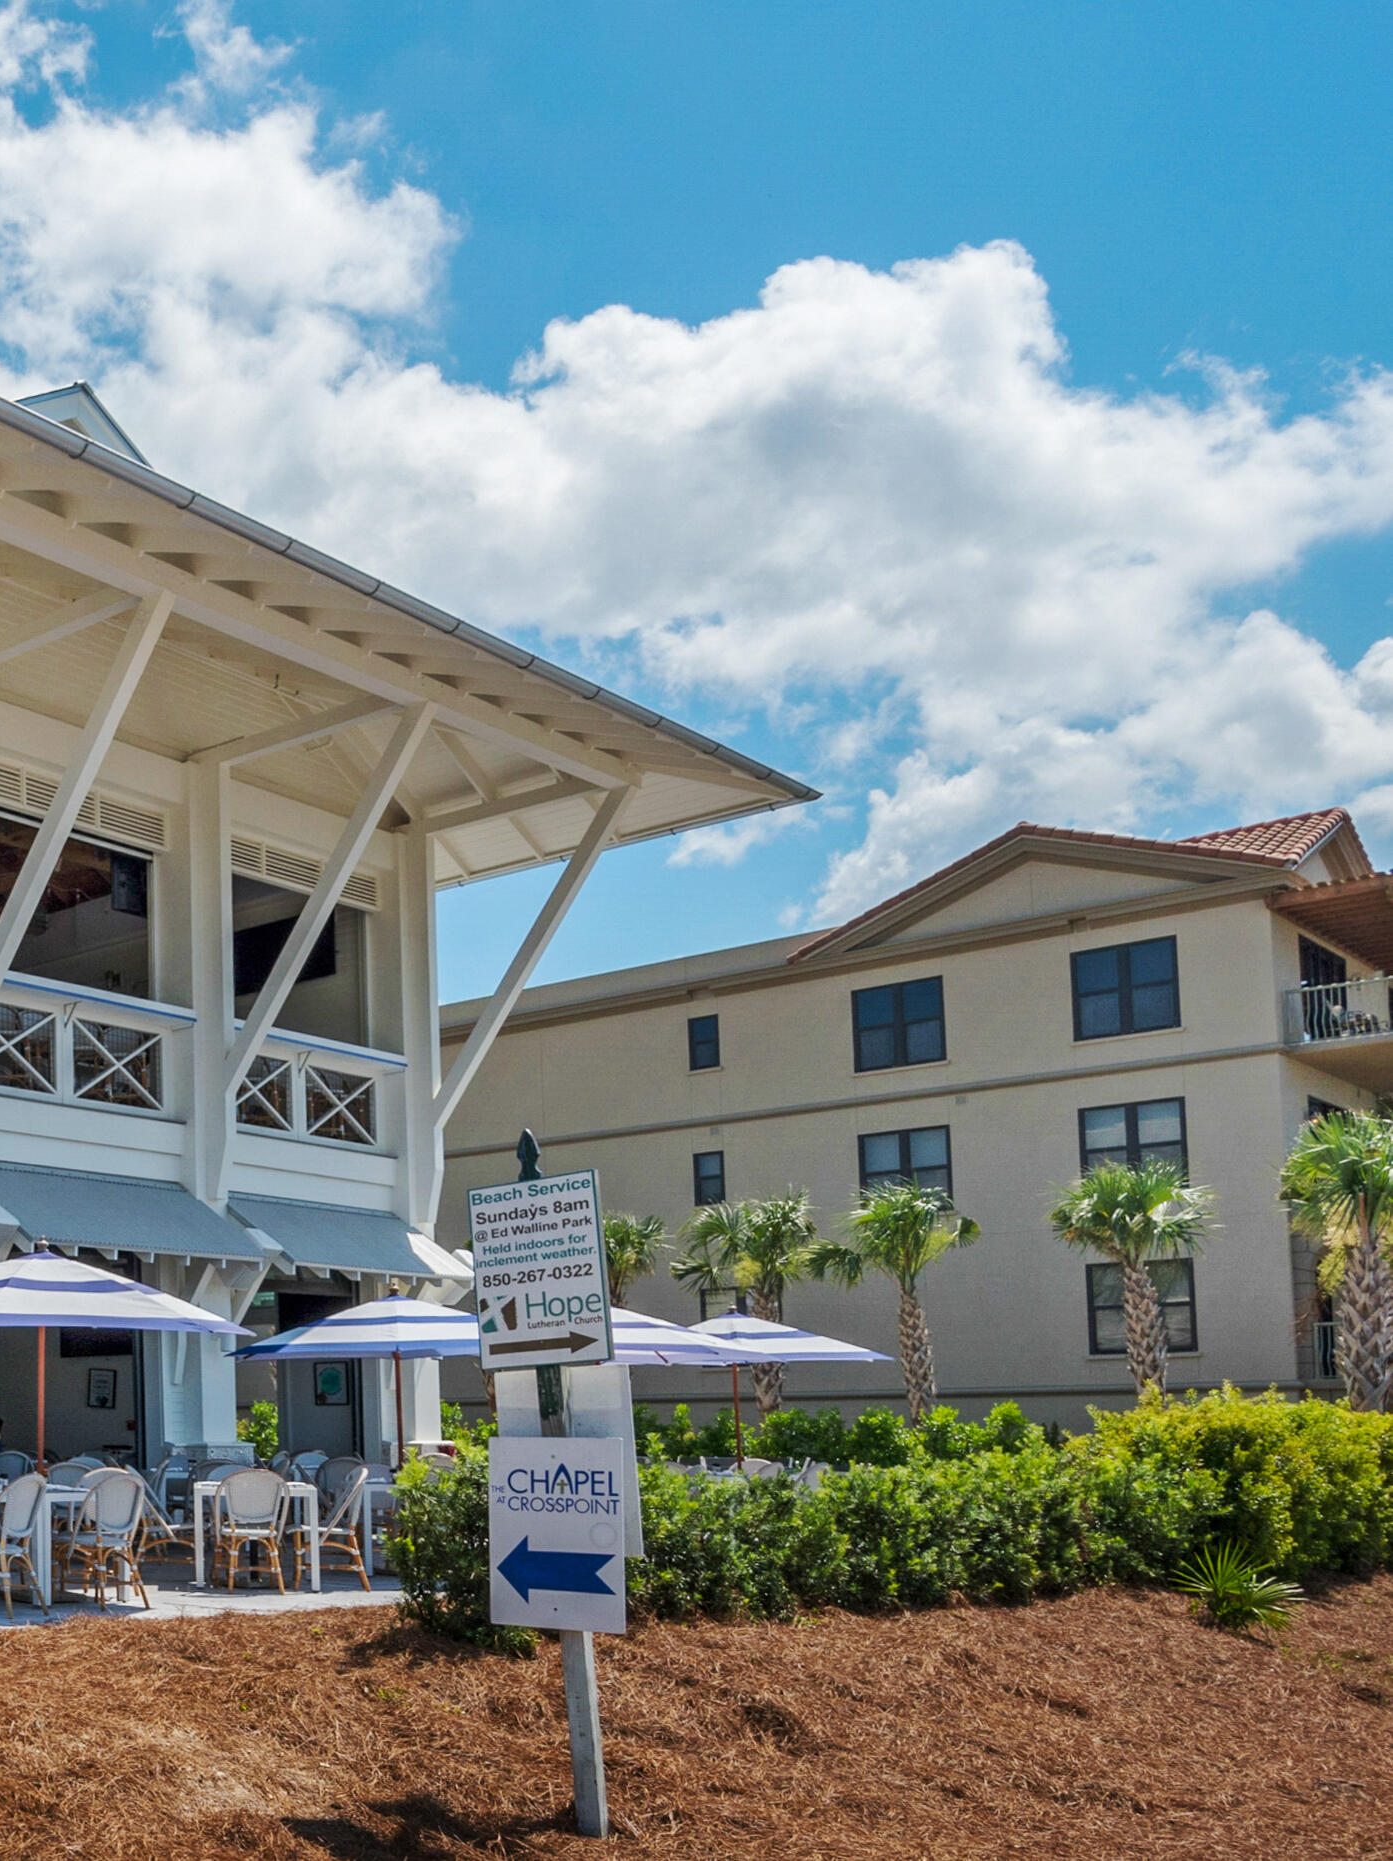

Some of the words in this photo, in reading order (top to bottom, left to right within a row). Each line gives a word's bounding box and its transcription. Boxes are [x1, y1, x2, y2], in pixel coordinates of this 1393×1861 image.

[472, 1188, 523, 1206] Beach
[528, 1179, 591, 1197] Service
[476, 1204, 548, 1225] Sundays
[553, 1199, 590, 1214] 8am
[474, 1230, 488, 1243] @
[491, 1227, 508, 1239] Ed
[511, 1221, 558, 1236] Walline
[562, 1216, 593, 1229] Park
[475, 1252, 538, 1269] inclement
[541, 1245, 597, 1261] weather.
[482, 1243, 511, 1256] Held
[515, 1237, 565, 1252] indoors
[568, 1233, 587, 1244] for
[482, 1263, 594, 1288] 850-267-0322
[525, 1291, 602, 1323] Hope
[527, 1319, 566, 1330] Lutheran
[574, 1315, 603, 1326] Church
[491, 1484, 505, 1494] THE
[507, 1463, 620, 1497] CHAPEL
[496, 1496, 506, 1505] AT
[507, 1496, 621, 1516] CROSSPOINT
